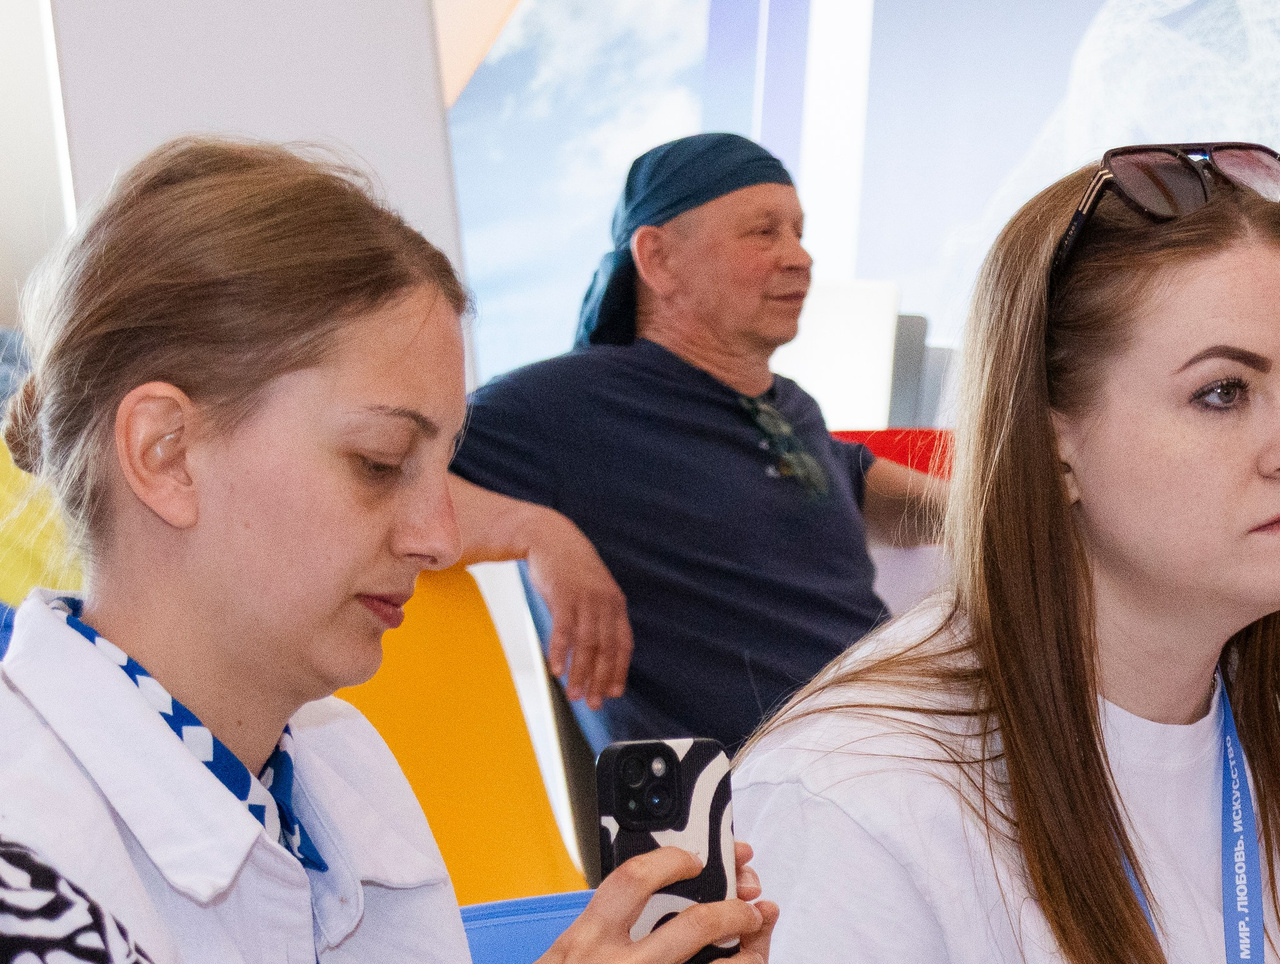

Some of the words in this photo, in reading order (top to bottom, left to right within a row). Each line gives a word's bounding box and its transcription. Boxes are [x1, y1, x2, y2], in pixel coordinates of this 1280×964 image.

[1225, 735, 1245, 832] ИСКУССТВО
[1233, 834, 1249, 913] ЛЮБОВЬ.
[1239, 916, 1252, 959] МИР.
